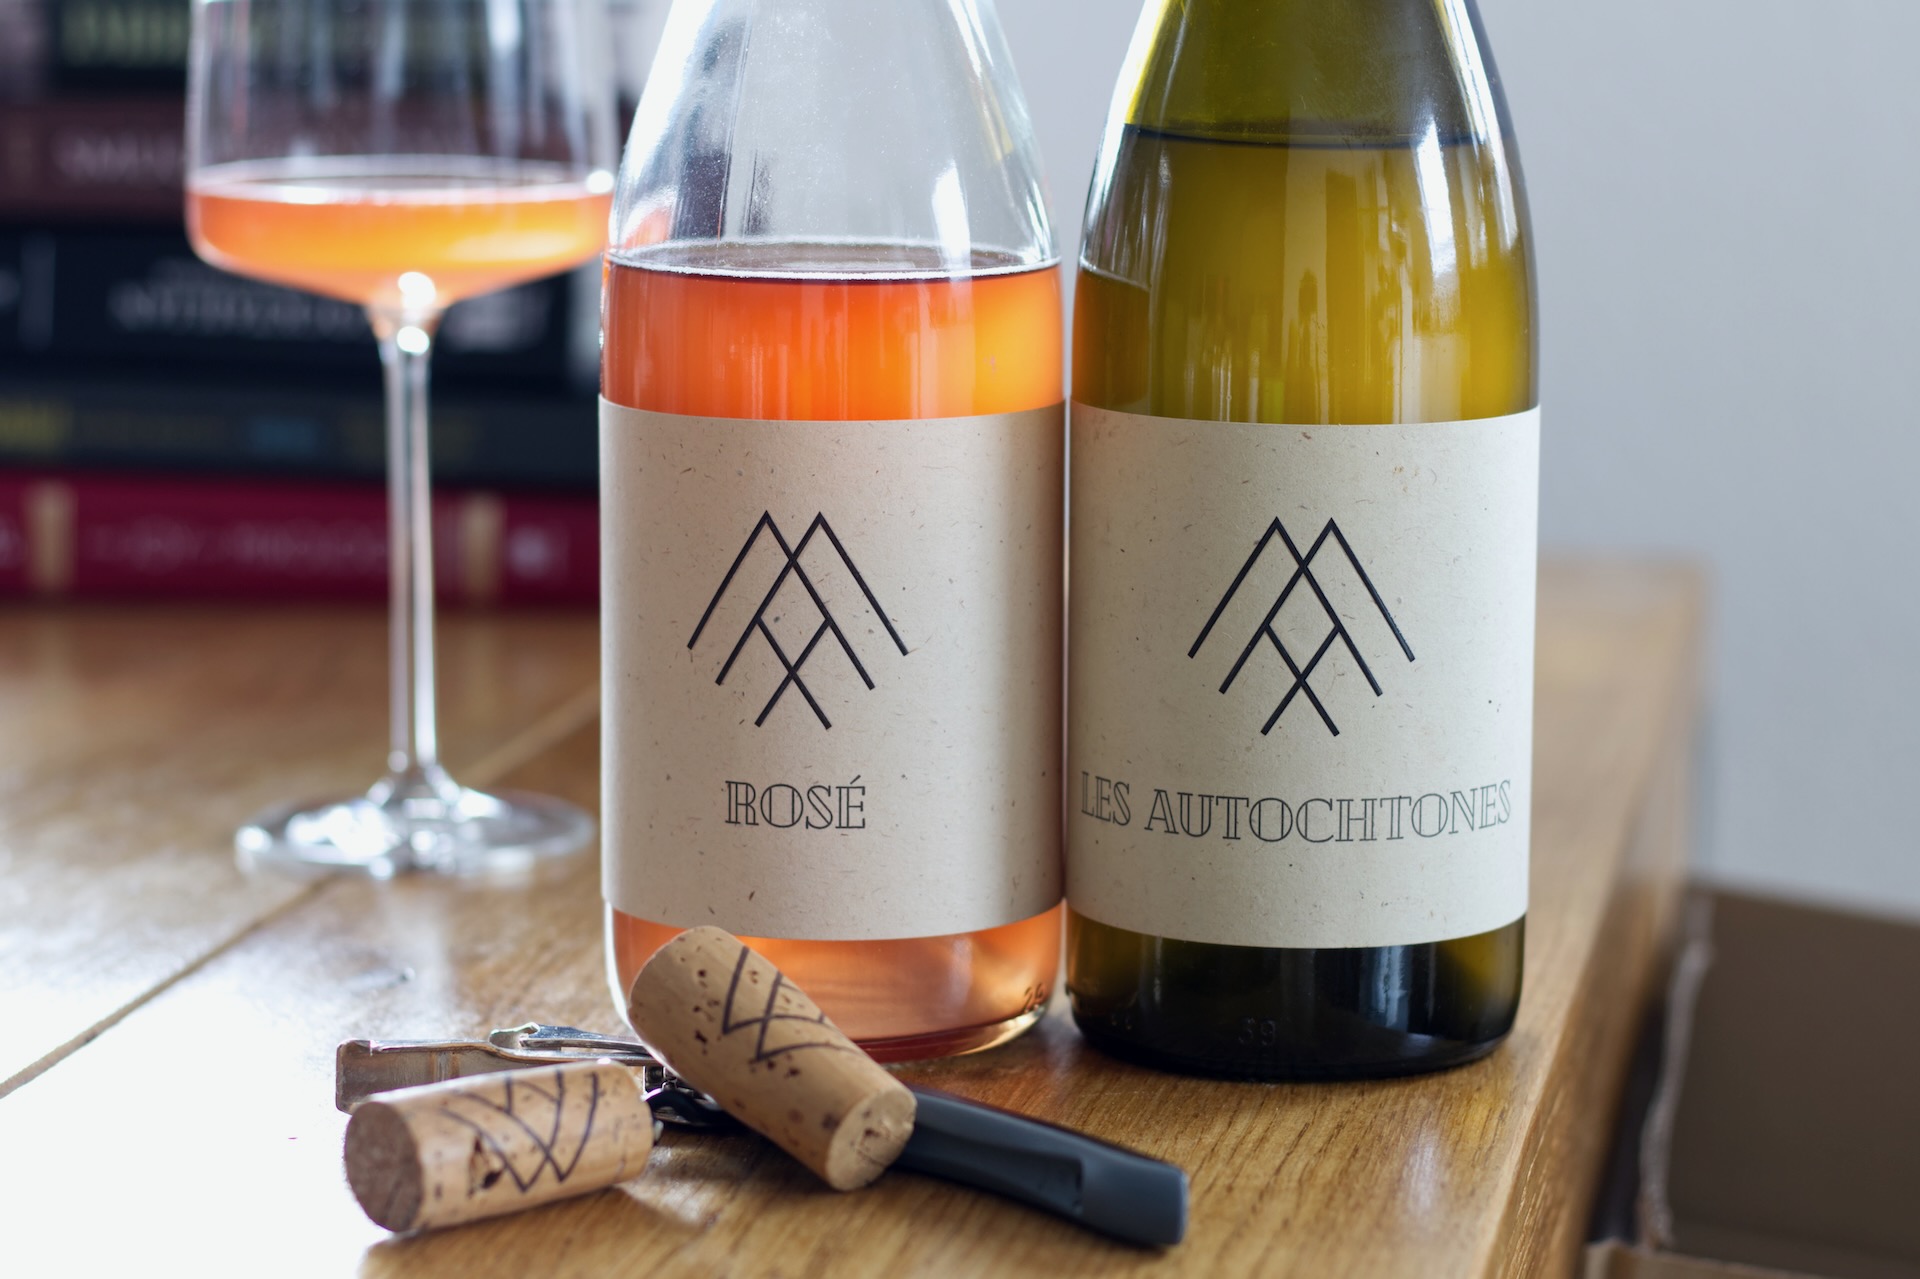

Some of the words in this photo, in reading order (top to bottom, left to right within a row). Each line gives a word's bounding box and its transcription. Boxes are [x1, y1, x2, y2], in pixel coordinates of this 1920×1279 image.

[725, 774, 866, 829] ROSÉ
[1081, 771, 1131, 826] LES
[1144, 779, 1511, 843] AUTOCHTONES
